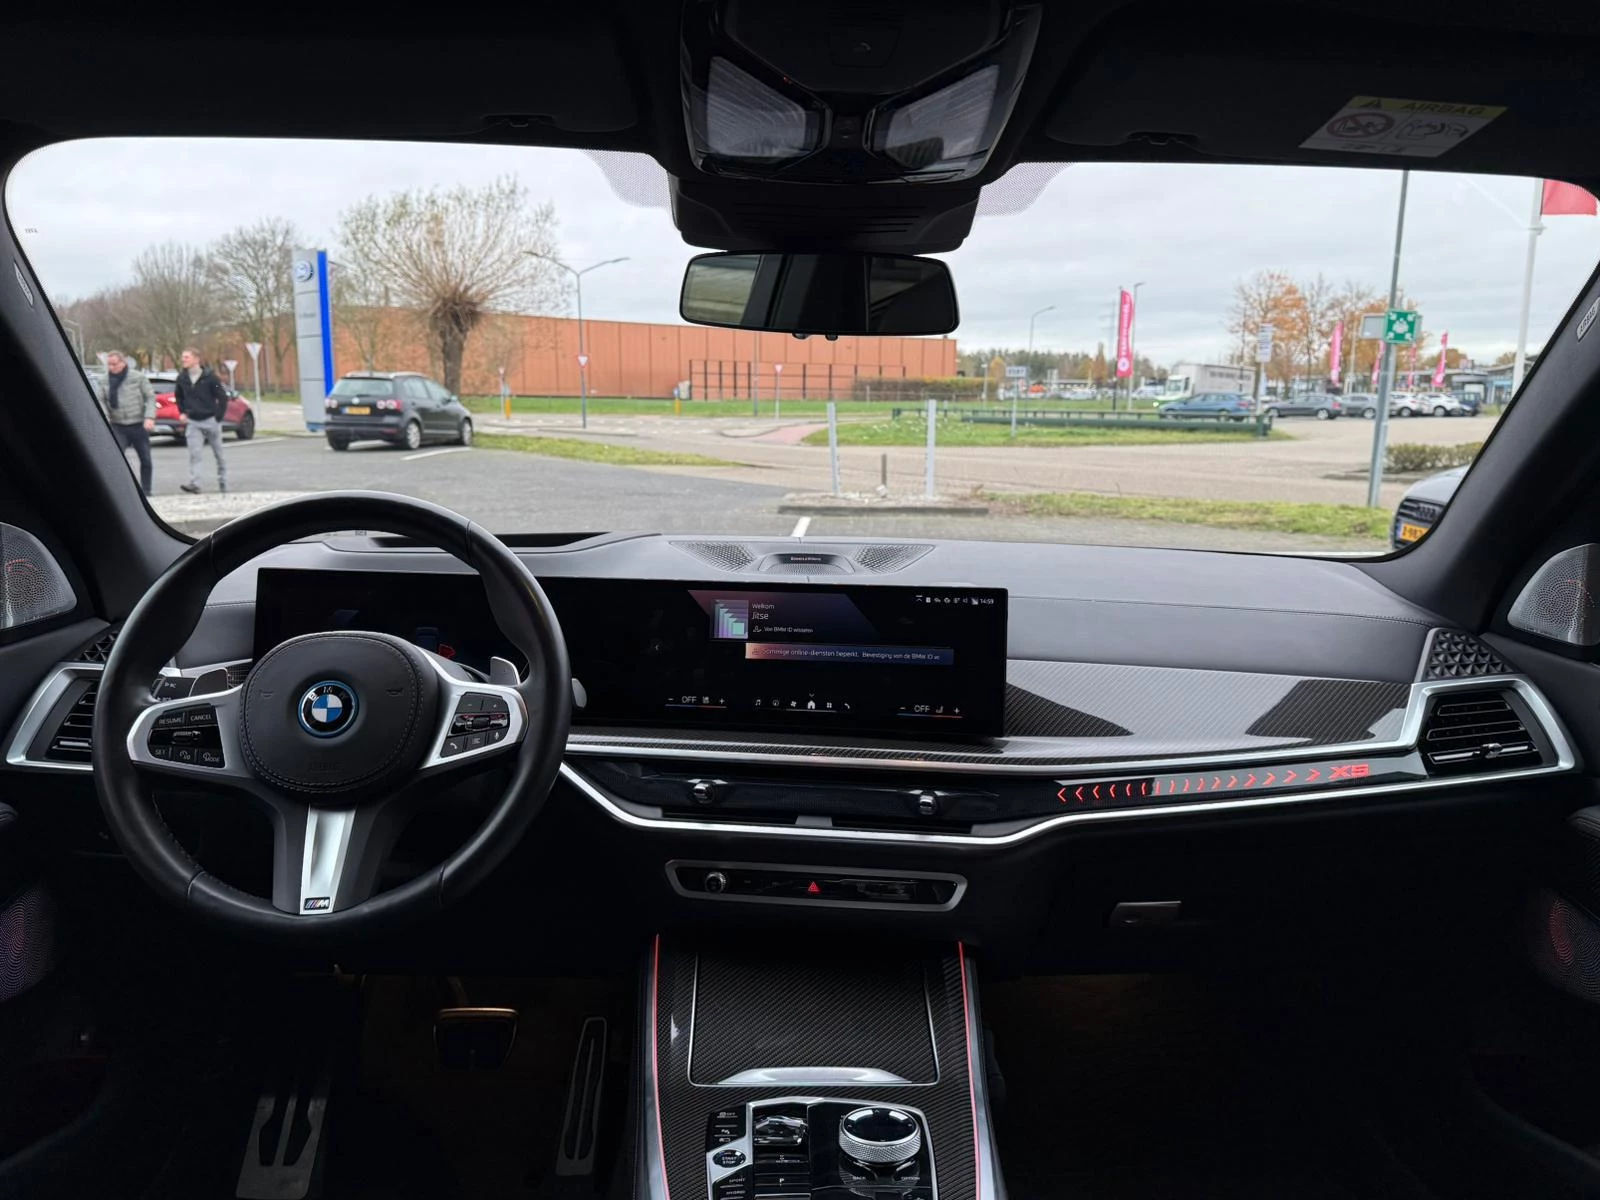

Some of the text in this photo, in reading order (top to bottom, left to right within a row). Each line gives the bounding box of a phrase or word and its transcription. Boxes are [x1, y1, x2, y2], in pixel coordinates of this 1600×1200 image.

[1400, 102, 1486, 115] AIRBAG
[1580, 306, 1595, 335] AIRBAG
[681, 696, 697, 704] OFF
[914, 705, 930, 713] OFF
[158, 713, 212, 725] RESUME CANCEL
[1328, 764, 1369, 781] X5
